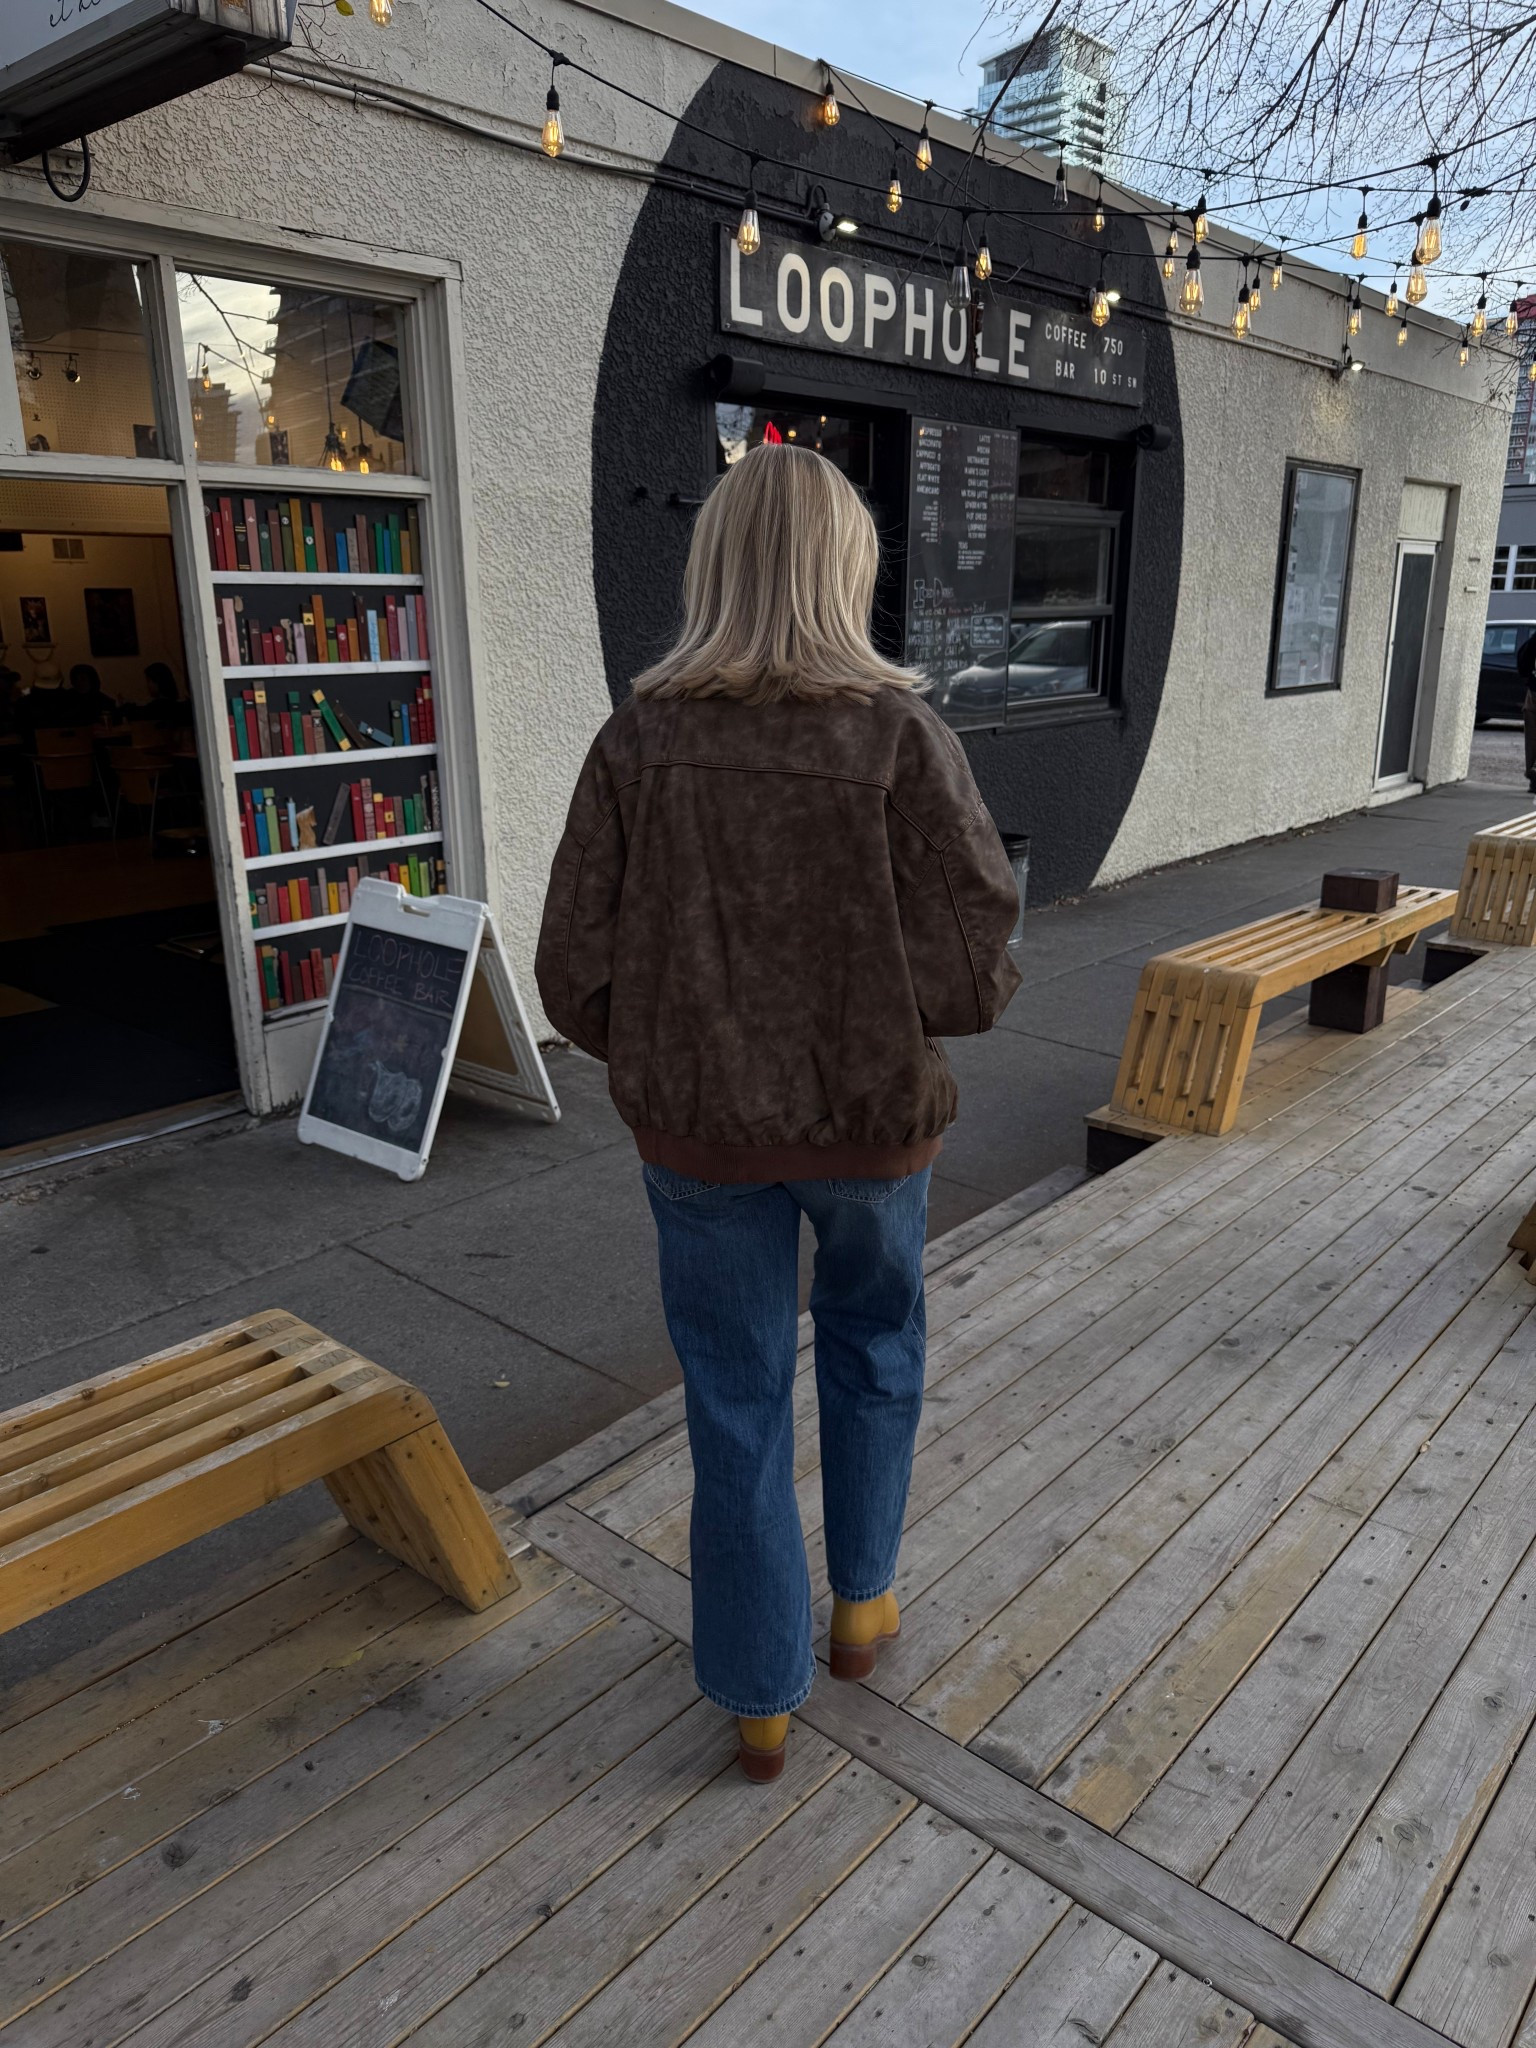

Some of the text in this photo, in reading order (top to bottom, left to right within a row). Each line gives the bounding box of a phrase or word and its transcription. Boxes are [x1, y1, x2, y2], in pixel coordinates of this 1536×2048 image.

[730, 238, 1031, 379] LOOPHOLE
[1045, 322, 1087, 349] COFFEE
[1103, 336, 1124, 356] 750
[1055, 359, 1075, 379] BAR
[1094, 368, 1107, 385] 10
[1112, 373, 1122, 386] ST
[354, 931, 464, 983] LOOPHOLE
[349, 962, 452, 1008] COFFEE BAR
